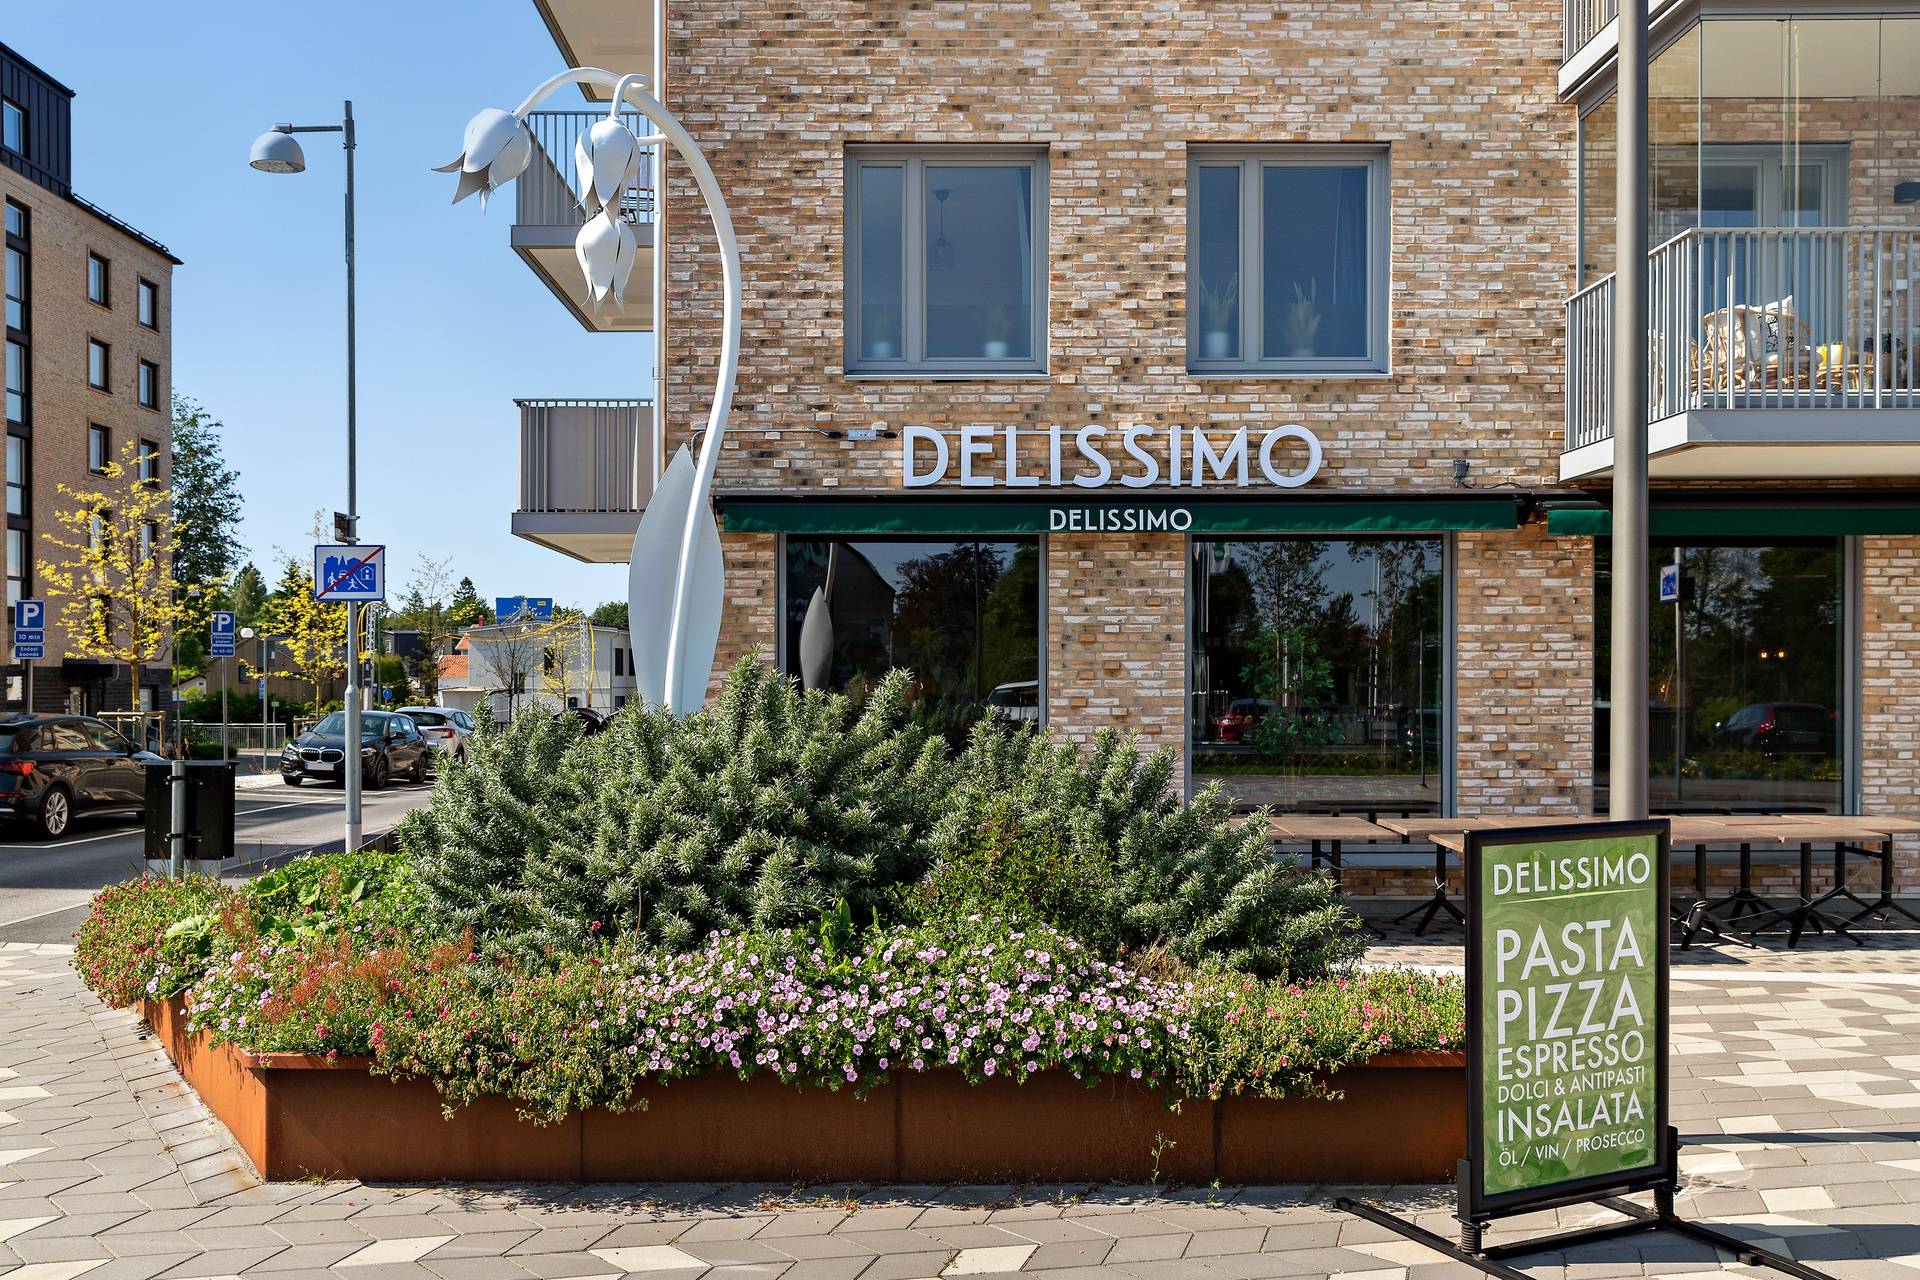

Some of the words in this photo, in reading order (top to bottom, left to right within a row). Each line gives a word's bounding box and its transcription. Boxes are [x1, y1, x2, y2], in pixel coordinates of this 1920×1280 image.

[903, 425, 1322, 488] DELISSIMO
[1049, 509, 1193, 531] DELISSIMO
[23, 604, 40, 626] P
[217, 614, 231, 631] P
[1493, 853, 1650, 896] DELISSIMO
[1496, 915, 1644, 983] PASTA
[1497, 974, 1644, 1045] PIZZA
[1498, 1030, 1644, 1081] ESPRESSO
[1498, 1080, 1549, 1104] DOLCI
[1554, 1078, 1565, 1096] &
[1570, 1065, 1645, 1093] ANTIPASTI
[1498, 1088, 1645, 1142] INSALATA
[1499, 1147, 1518, 1166] ÖL
[1535, 1143, 1559, 1160] VIN
[1576, 1128, 1645, 1153] PROSECCO
